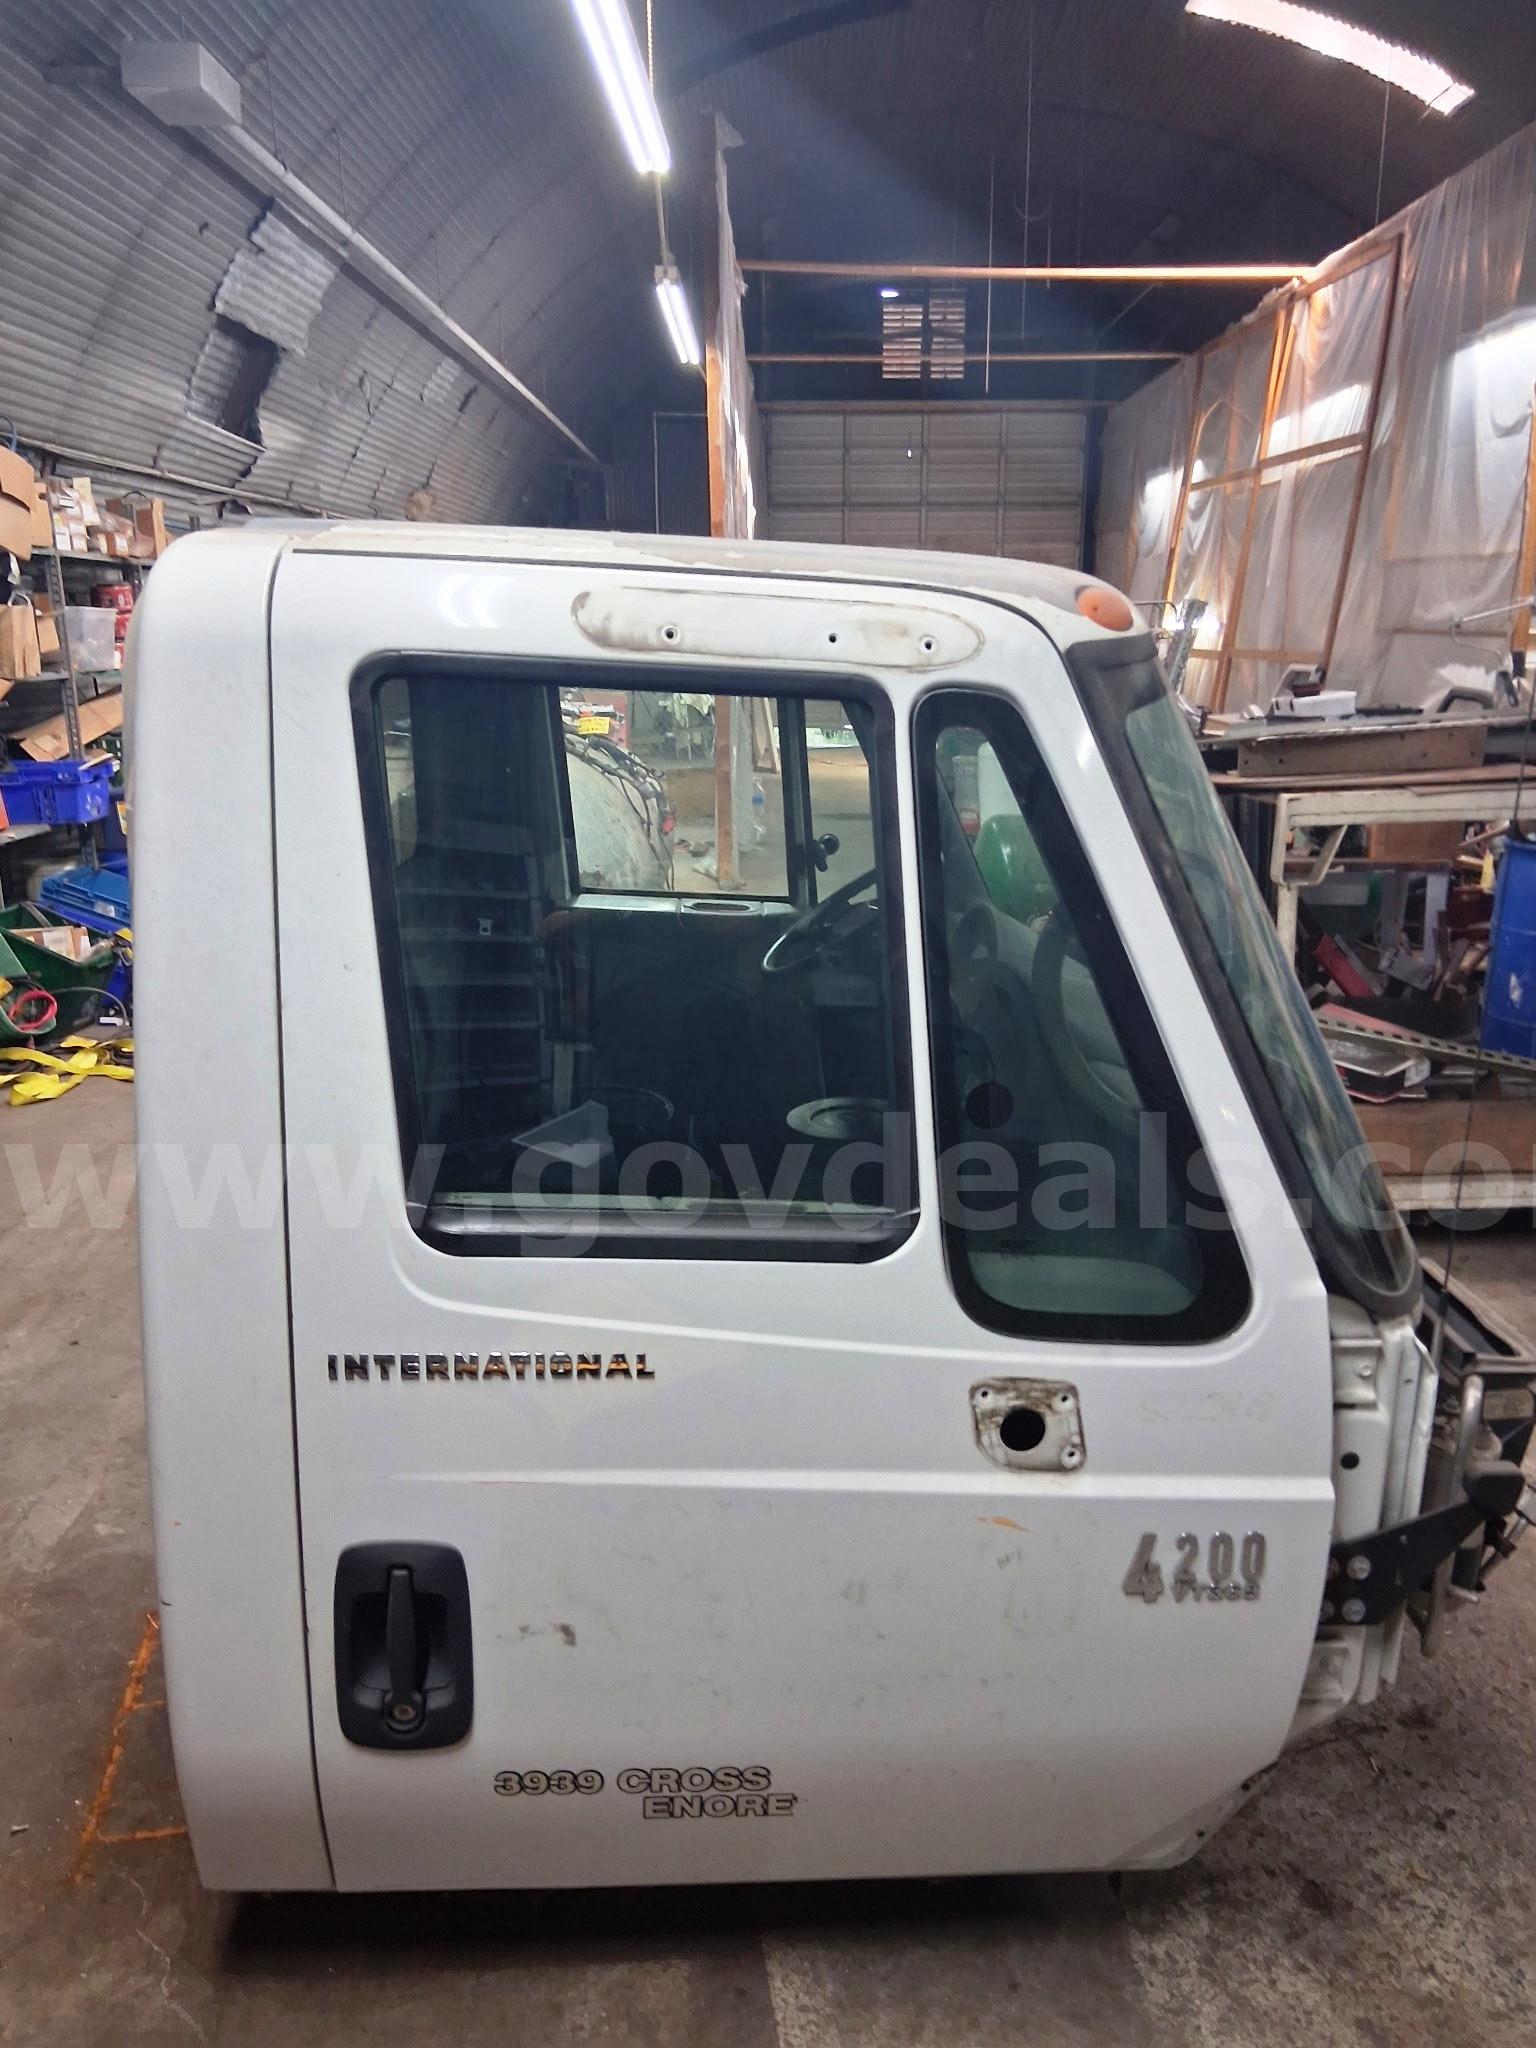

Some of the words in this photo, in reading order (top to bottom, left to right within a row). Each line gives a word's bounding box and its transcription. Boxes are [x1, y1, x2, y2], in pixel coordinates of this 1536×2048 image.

[327, 1350, 656, 1381] INTERNATIONAL
[1123, 1530, 1267, 1604] 4200
[494, 1769, 604, 1796] 3939
[616, 1765, 772, 1794] CROSS
[642, 1793, 797, 1820] ENORE
